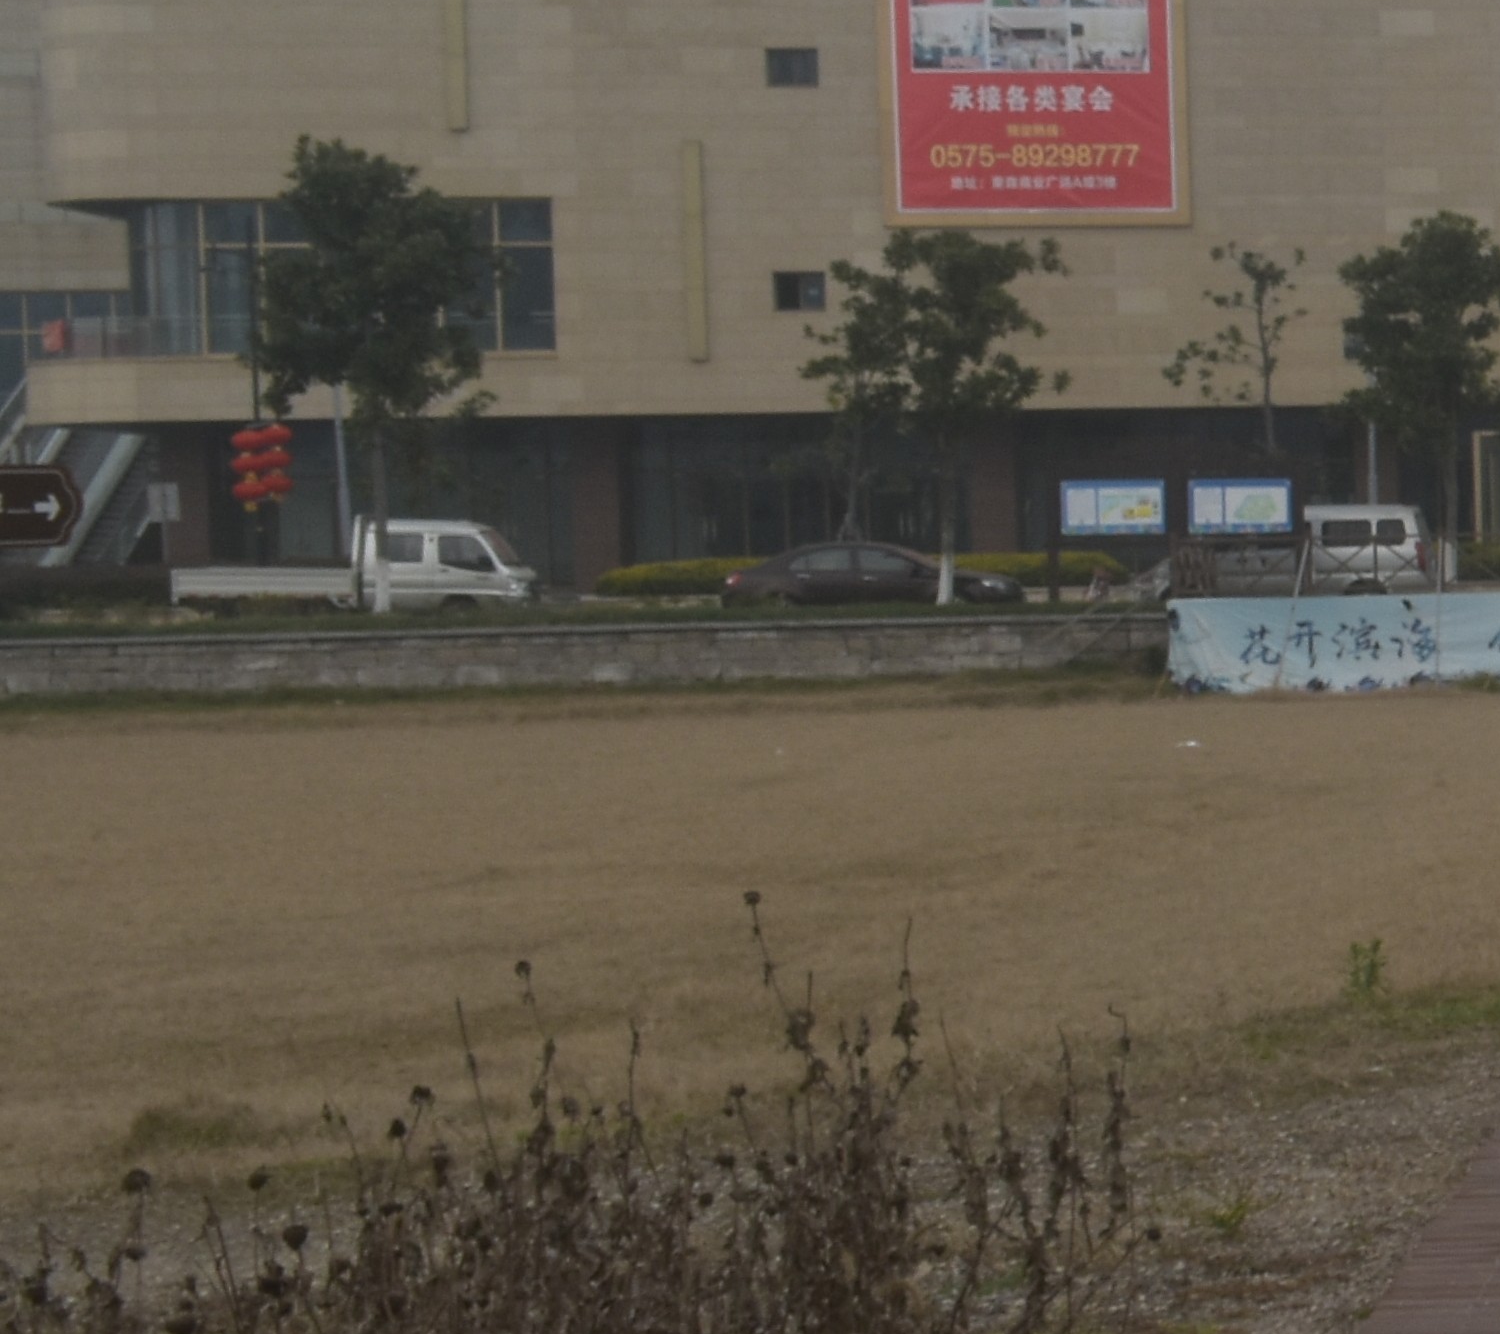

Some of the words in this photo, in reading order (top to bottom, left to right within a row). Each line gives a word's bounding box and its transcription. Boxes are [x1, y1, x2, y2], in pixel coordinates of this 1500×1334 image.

[949, 83, 1115, 112] 承接各类宴会
[930, 142, 1141, 169] 0575-89298777
[1240, 617, 1438, 667] 花开滨海
